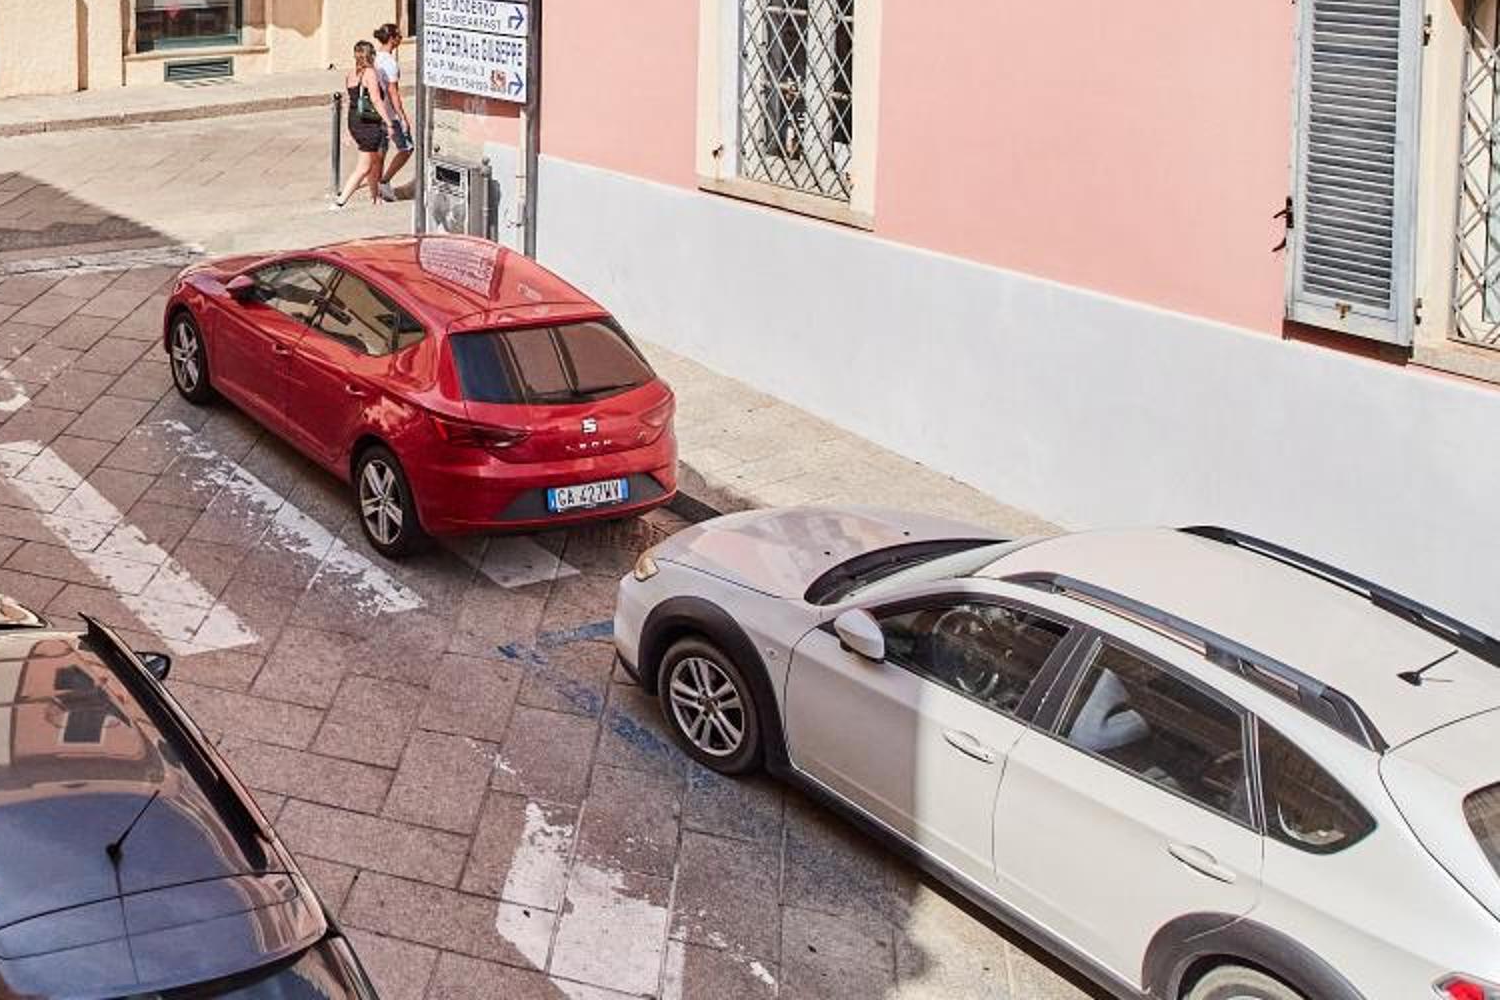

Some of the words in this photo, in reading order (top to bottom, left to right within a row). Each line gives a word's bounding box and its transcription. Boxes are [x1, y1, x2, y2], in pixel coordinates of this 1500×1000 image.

[453, 0, 498, 17] MODERNO
[450, 15, 501, 31] BREAKFAST
[558, 489, 575, 507] GA
